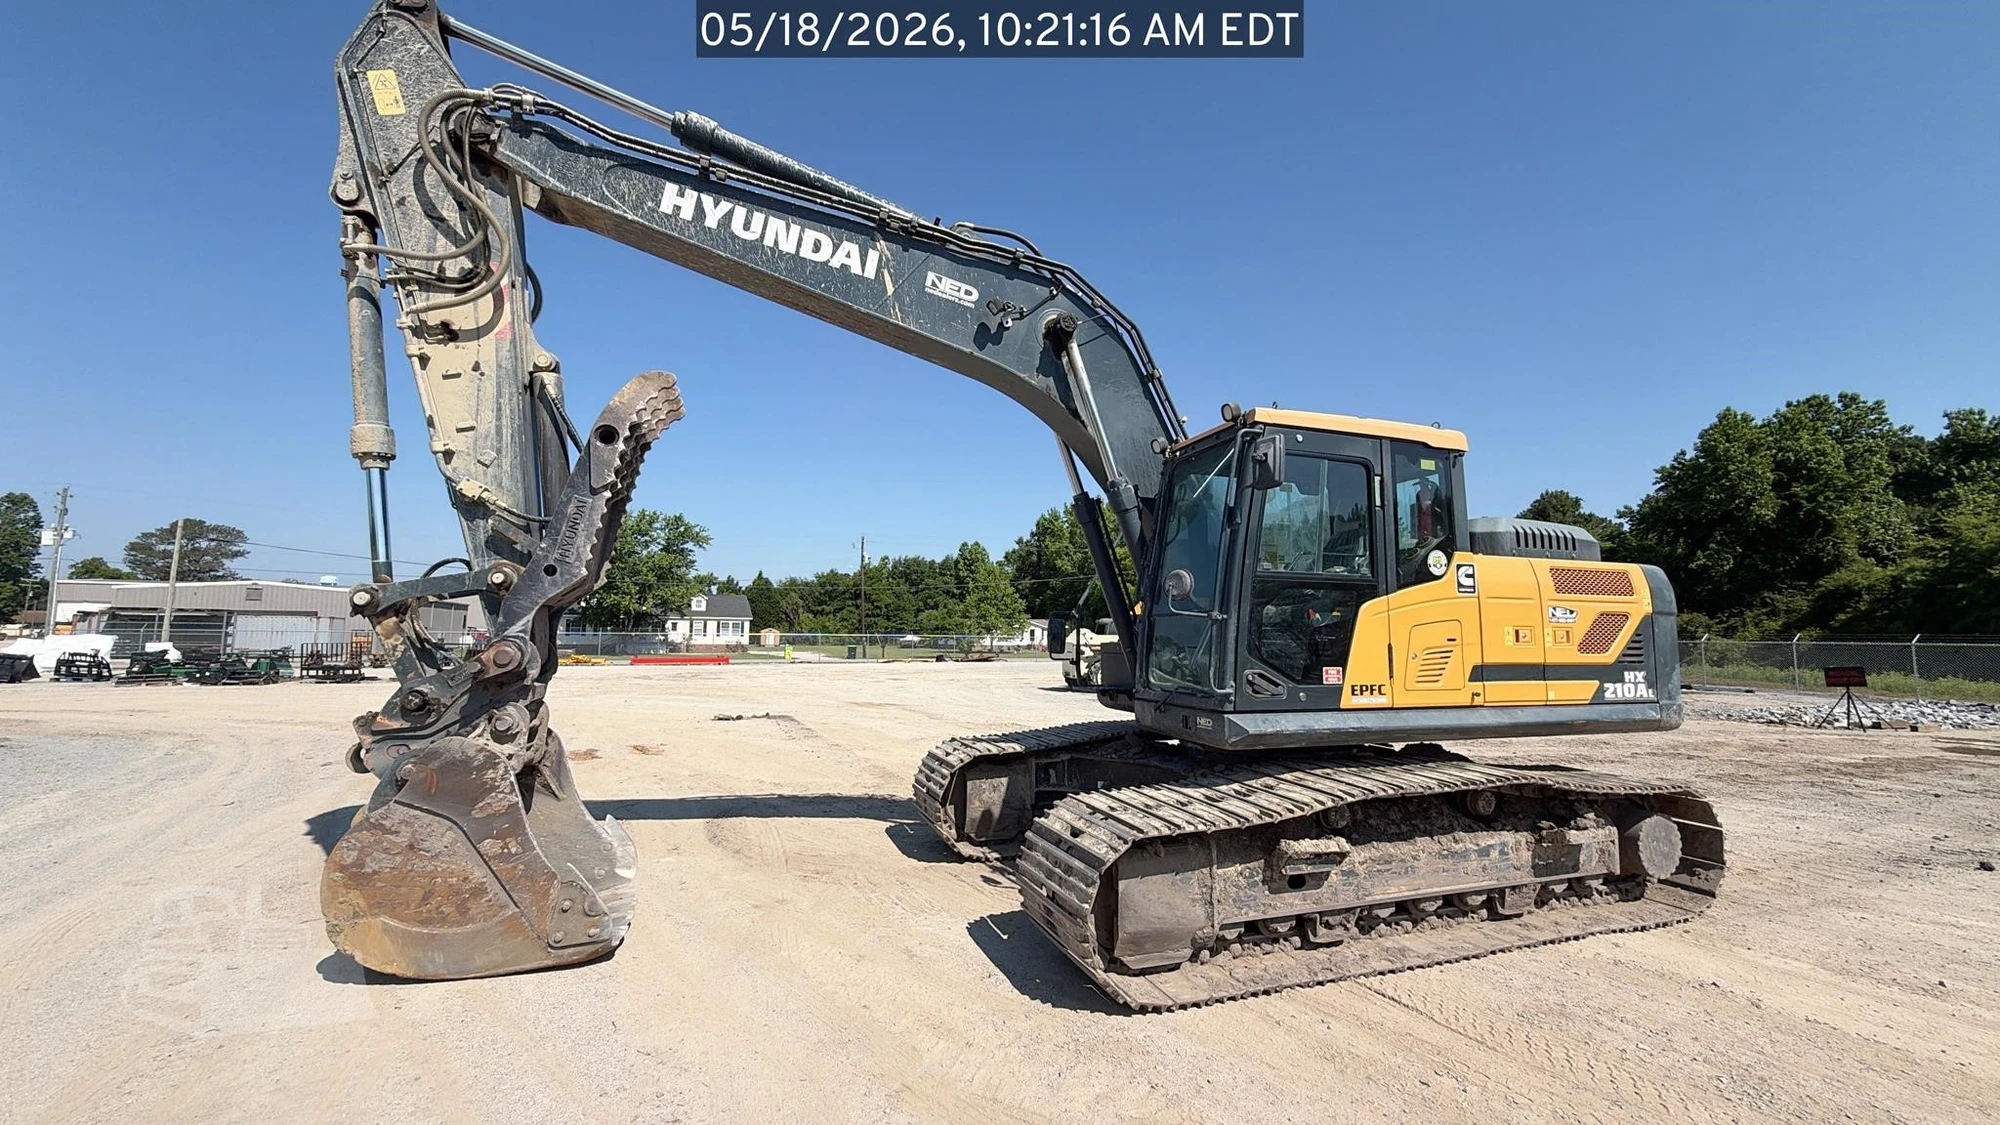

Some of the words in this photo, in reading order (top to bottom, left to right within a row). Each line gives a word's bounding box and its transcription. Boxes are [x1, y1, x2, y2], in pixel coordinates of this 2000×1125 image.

[658, 181, 881, 280] HYUNDAI
[925, 270, 980, 302] NED
[559, 498, 588, 560] HYUNDAI
[1623, 671, 1646, 683] HX
[1350, 684, 1387, 696] EPFC
[1196, 716, 1213, 726] NED
